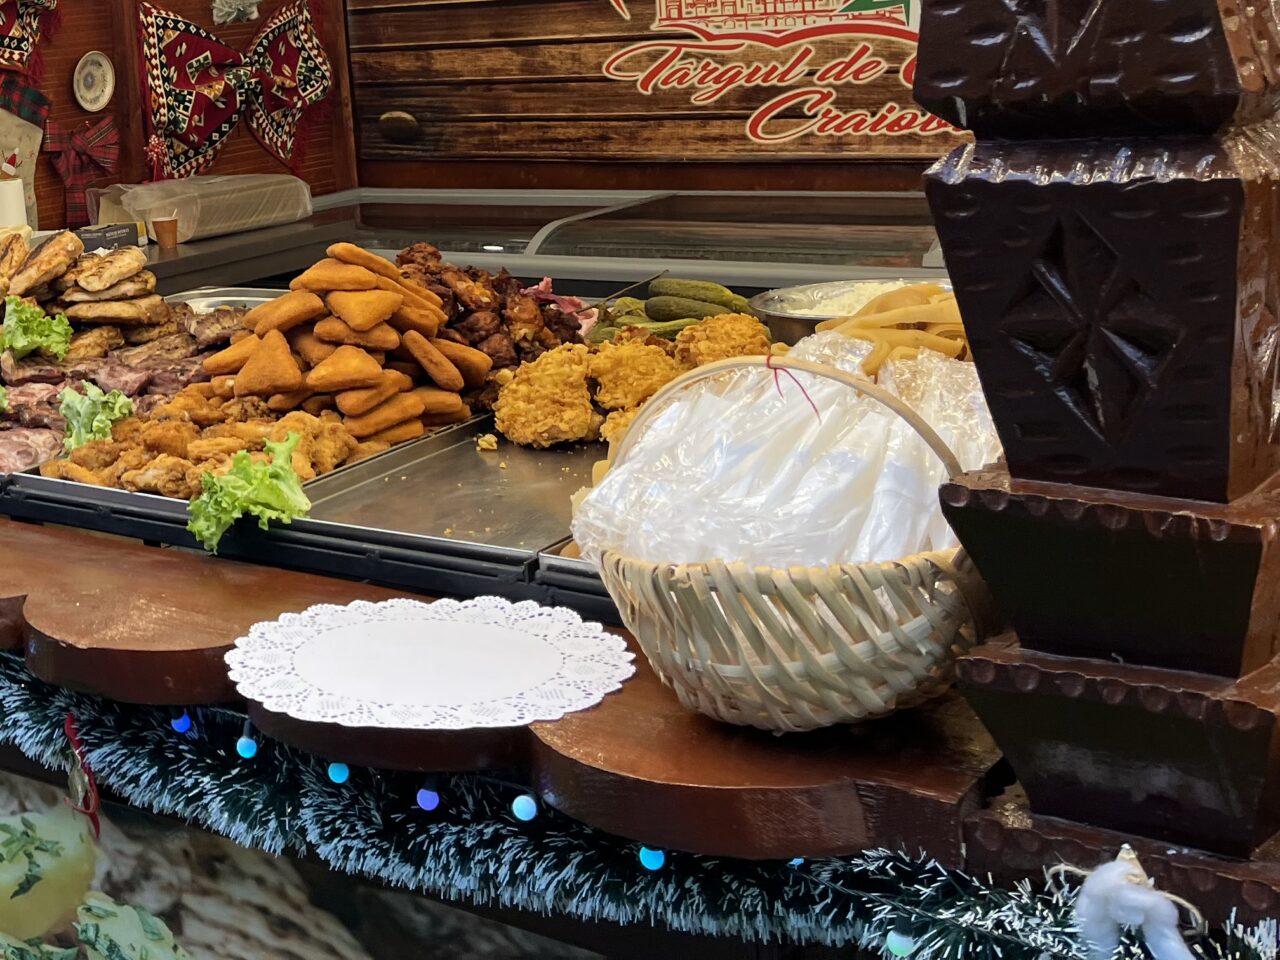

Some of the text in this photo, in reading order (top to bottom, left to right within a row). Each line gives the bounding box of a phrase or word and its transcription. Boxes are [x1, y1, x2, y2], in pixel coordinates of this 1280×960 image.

[605, 41, 813, 102] Târgul
[816, 44, 883, 83] de
[749, 88, 963, 141] Craiov
